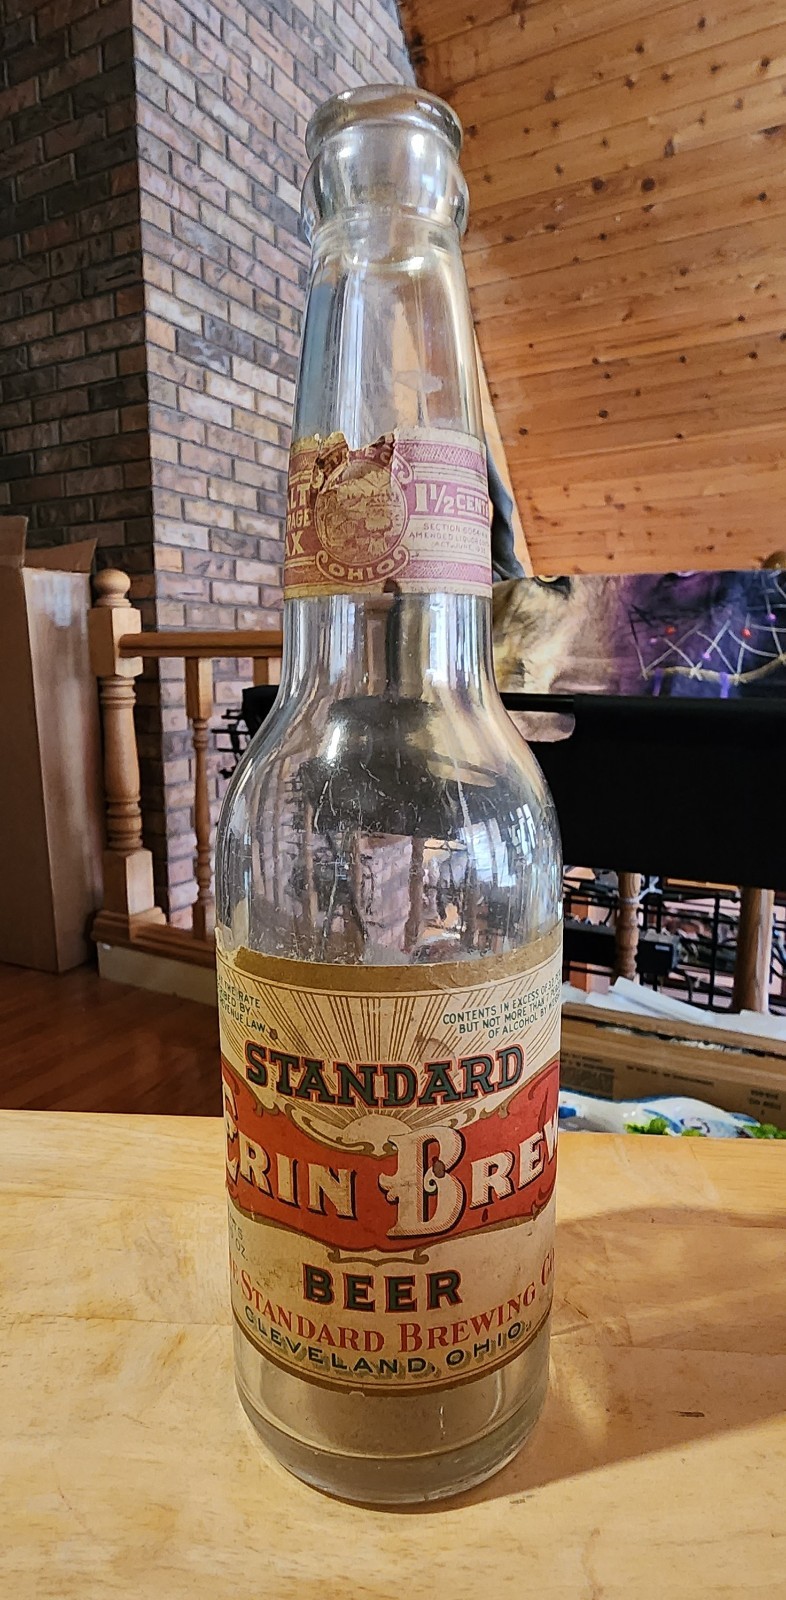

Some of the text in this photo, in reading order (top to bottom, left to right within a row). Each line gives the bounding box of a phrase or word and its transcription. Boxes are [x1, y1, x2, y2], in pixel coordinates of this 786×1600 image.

[409, 532, 454, 541] AMENDED
[423, 523, 460, 532] SECTION
[329, 554, 396, 581] OHIO
[238, 990, 261, 1009] RATE
[240, 1002, 251, 1015] BY
[443, 1005, 497, 1025] CONTENTS
[500, 1001, 510, 1014] IN
[512, 988, 539, 1009] EXCESS
[459, 1021, 479, 1034] BUT
[483, 1016, 501, 1029] NOT
[504, 1008, 527, 1024] MORE
[529, 997, 545, 1012] THAN
[246, 1016, 266, 1033] LAW
[488, 1026, 500, 1039] OF
[502, 1013, 538, 1035] ALCOHOL
[540, 1007, 547, 1017] BY
[245, 1040, 525, 1108] STANDARD
[224, 1082, 358, 1221] ERIN
[302, 1262, 463, 1313] BEER
[241, 1269, 385, 1353] STANDARD
[397, 1282, 536, 1353] BREWING
[244, 1305, 437, 1376] CLEVELAND,
